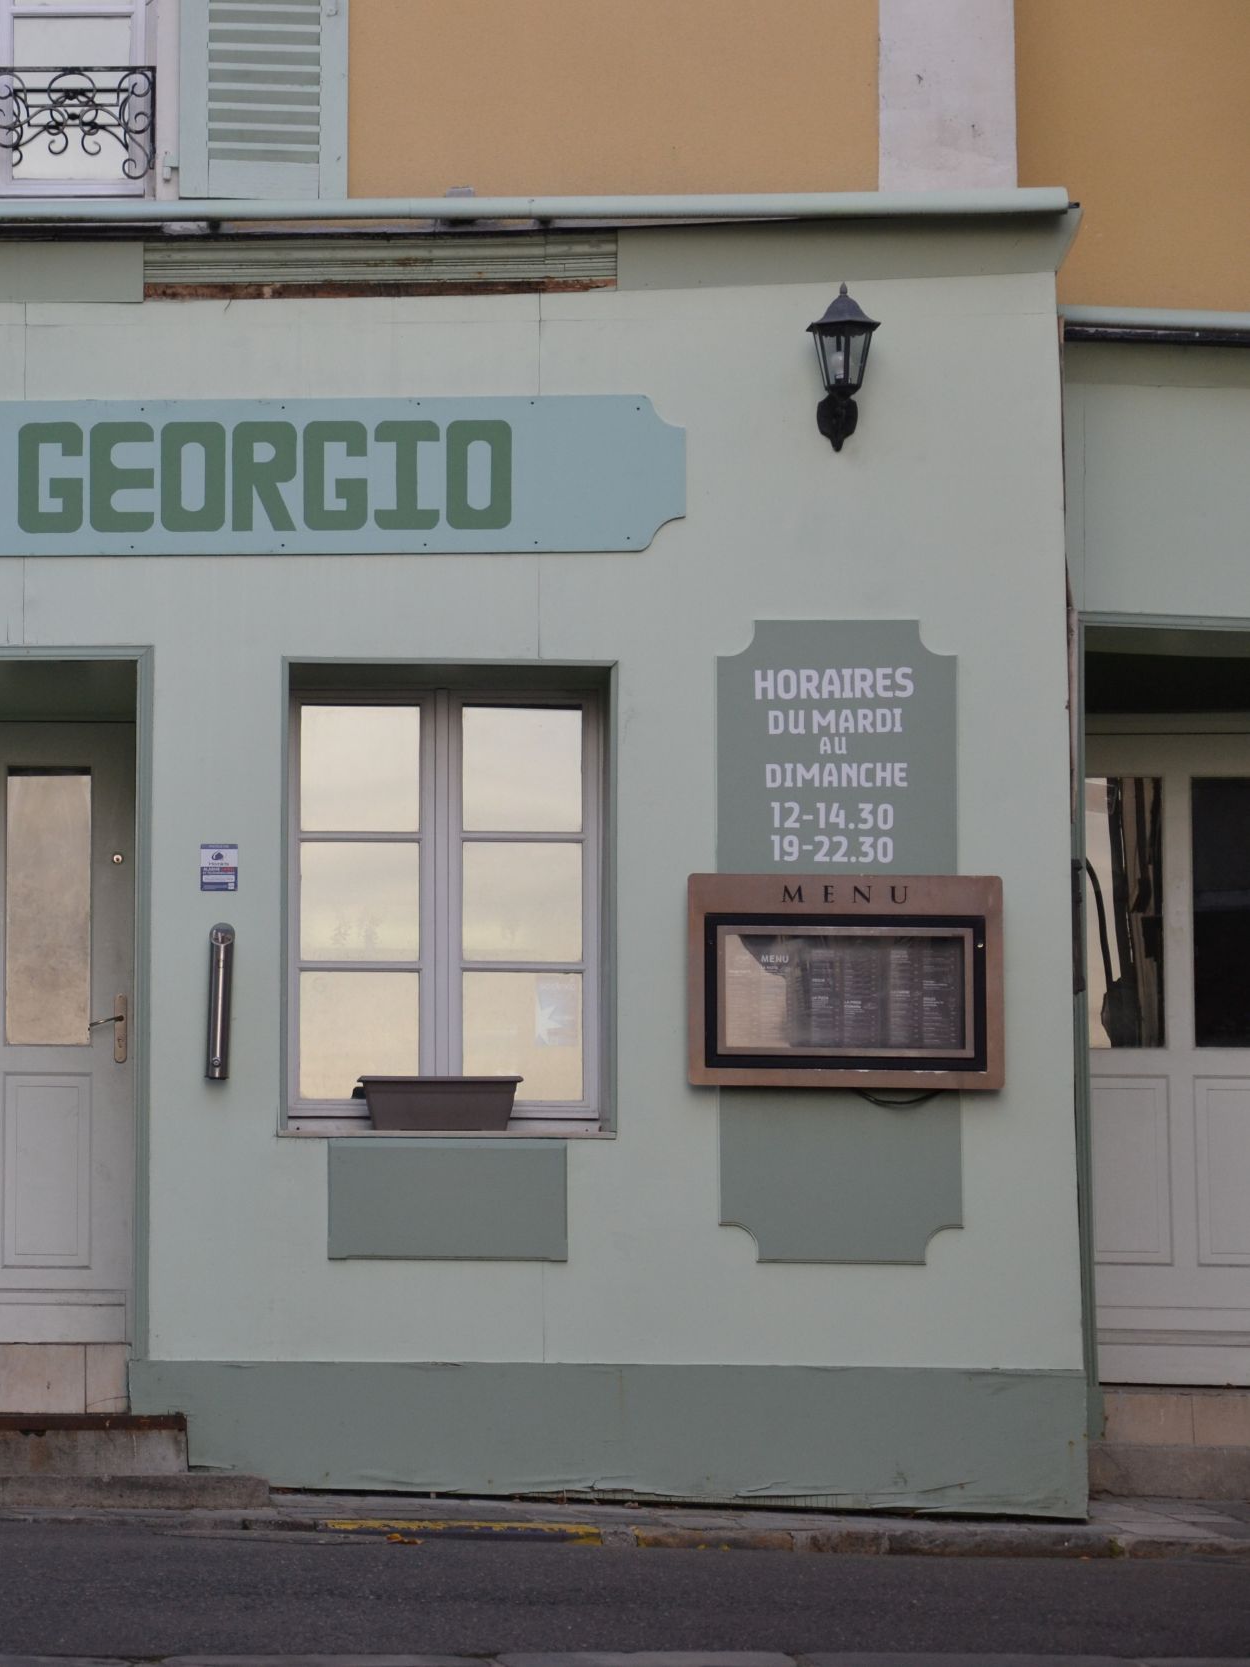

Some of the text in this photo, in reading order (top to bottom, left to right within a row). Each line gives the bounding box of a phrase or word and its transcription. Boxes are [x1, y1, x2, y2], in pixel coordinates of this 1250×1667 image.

[17, 420, 513, 534] GEORGIO
[754, 667, 914, 700] HORAIRES
[768, 708, 903, 735] DU MARDI
[819, 736, 847, 755] AU
[765, 762, 908, 788] DIMANCHE
[770, 801, 894, 831] 12-14.30
[770, 834, 894, 864] 19-22.30
[781, 884, 909, 905] MENU
[760, 954, 789, 963] MENU
